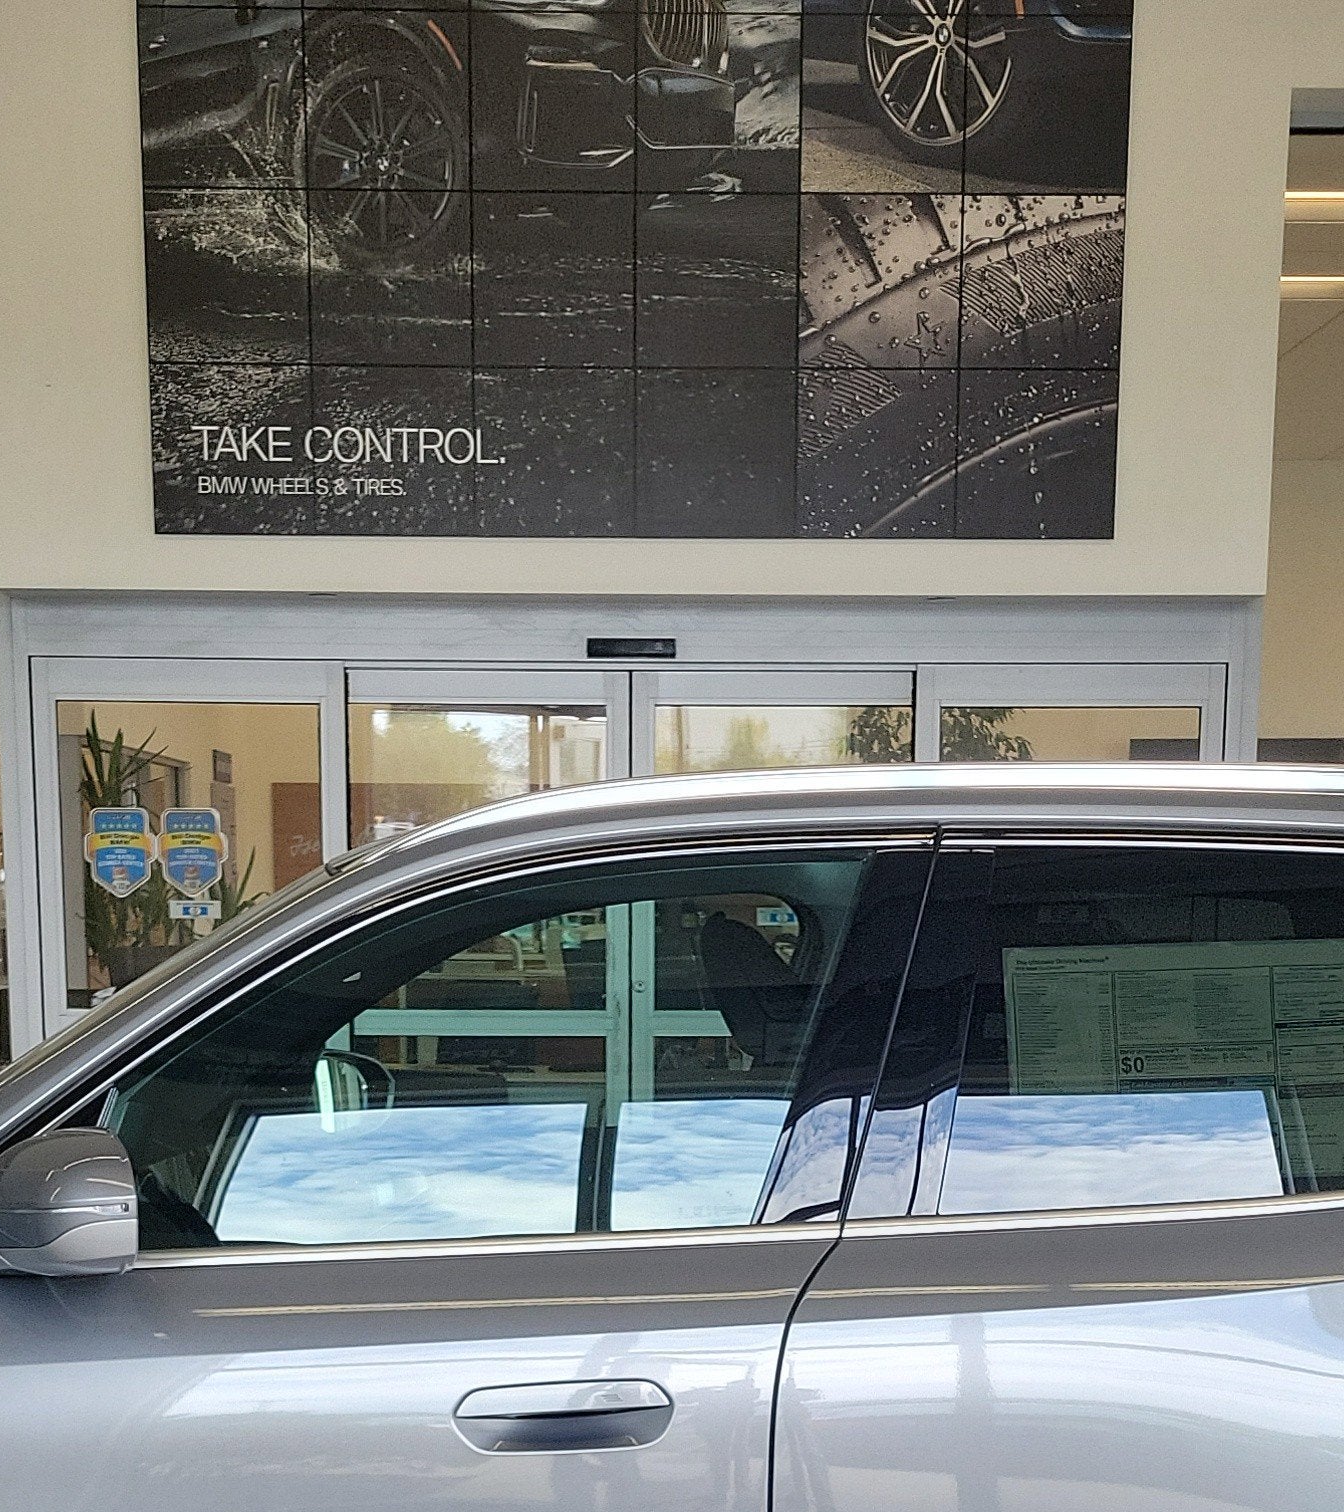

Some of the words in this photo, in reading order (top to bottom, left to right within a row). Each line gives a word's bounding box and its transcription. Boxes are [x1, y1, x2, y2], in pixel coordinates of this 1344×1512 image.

[191, 426, 293, 462] TAKE
[305, 426, 506, 465] CONTROL.
[197, 476, 248, 495] BMW
[251, 477, 330, 496] WHEELS
[334, 478, 348, 496] &
[352, 478, 408, 497] TIRES.
[1121, 1056, 1145, 1075] $0
